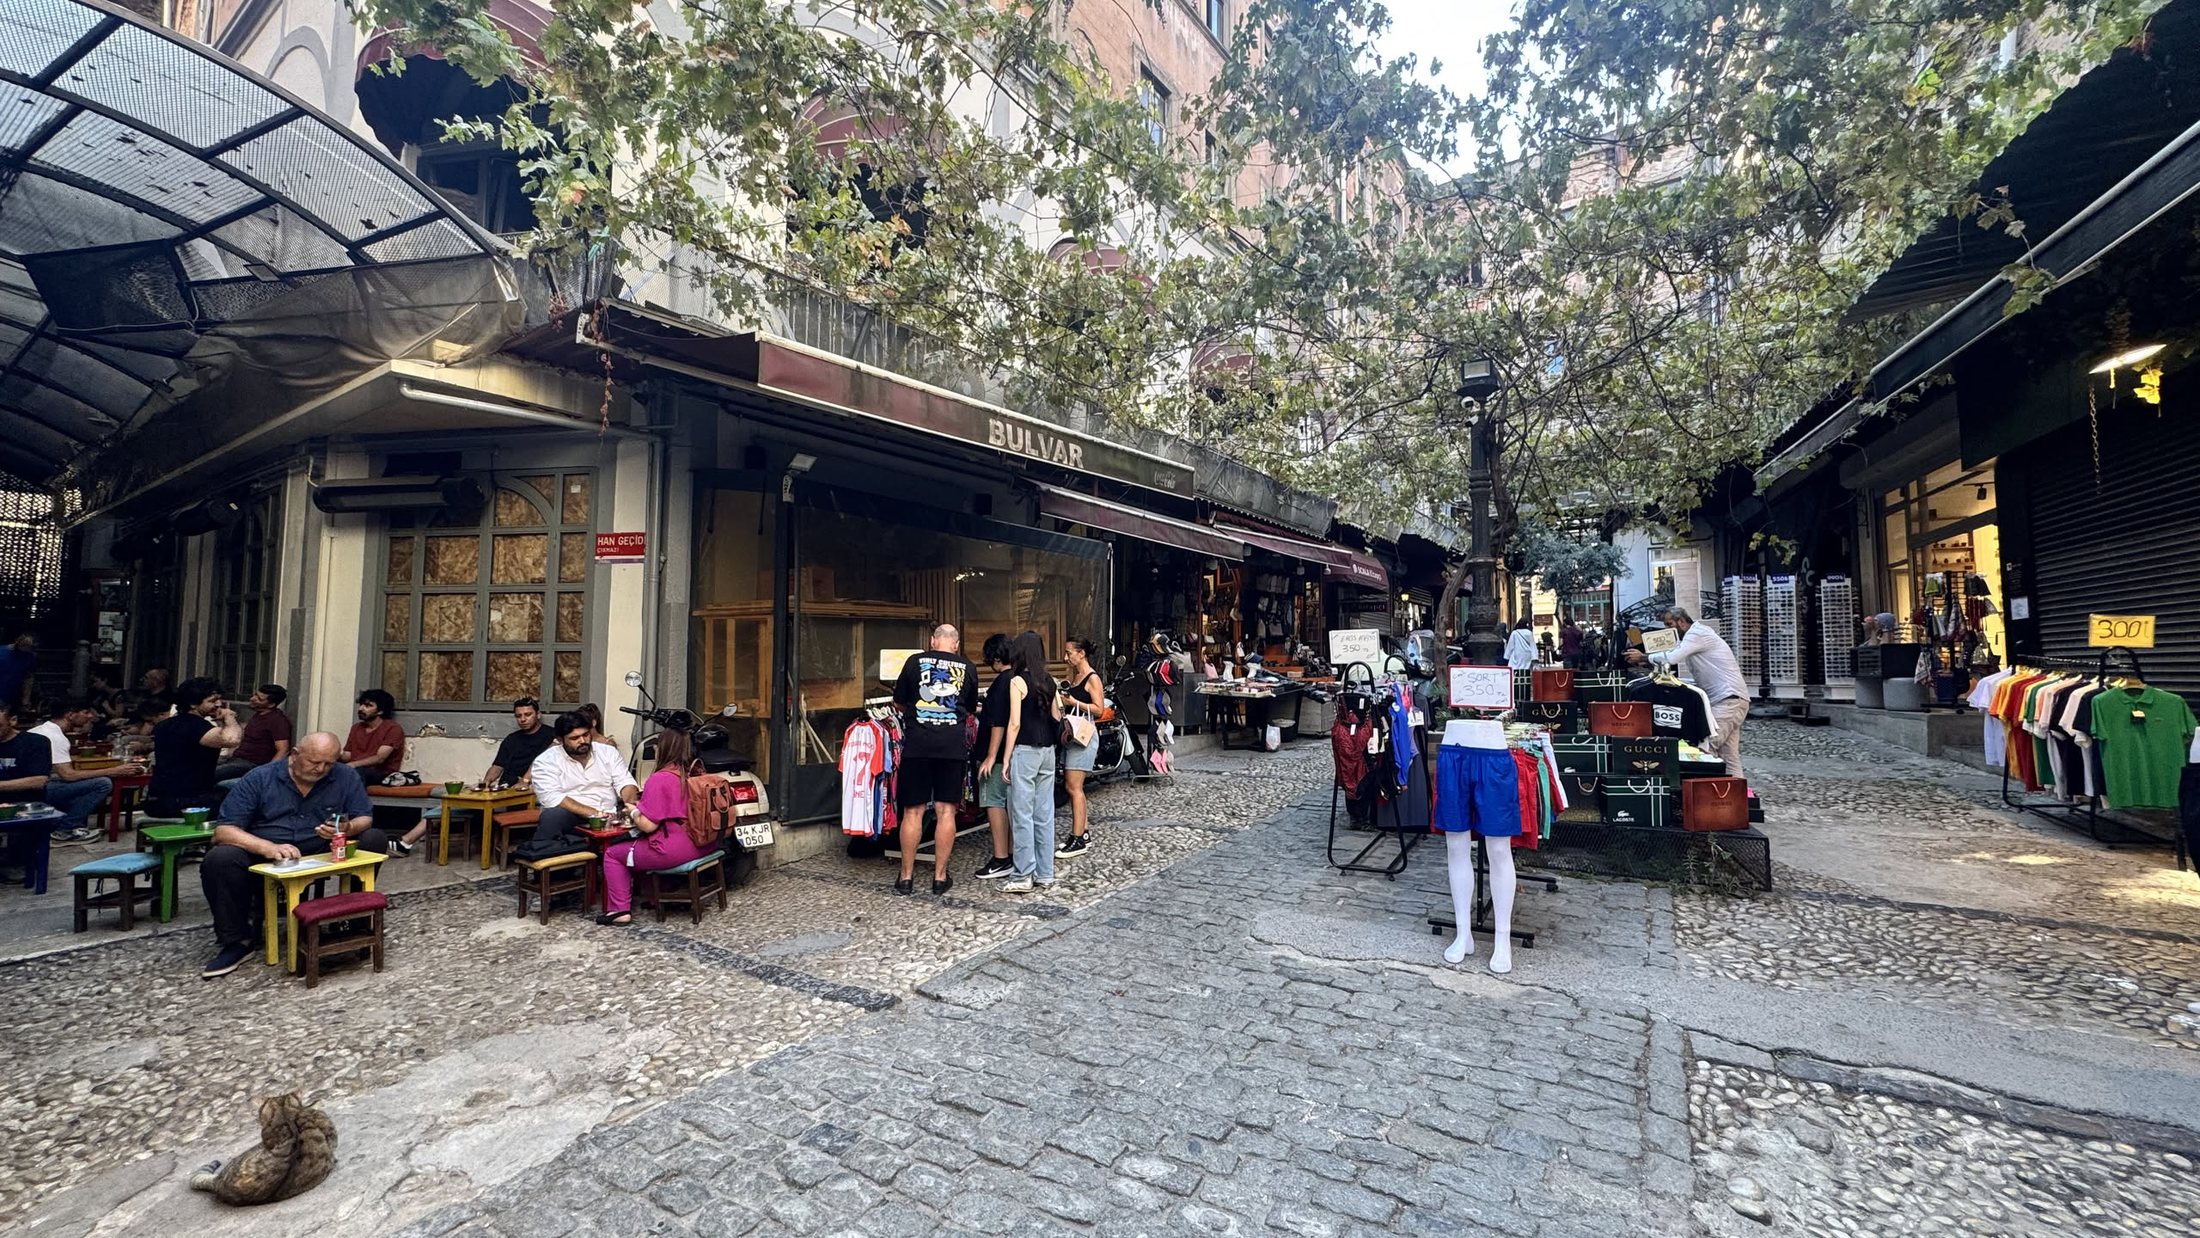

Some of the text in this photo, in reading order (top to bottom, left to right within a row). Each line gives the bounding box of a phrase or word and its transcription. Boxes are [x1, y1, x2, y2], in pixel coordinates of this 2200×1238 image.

[988, 417, 1085, 469] BULVAR
[597, 536, 616, 546] HAN
[1342, 643, 1361, 653] 350
[1462, 684, 1495, 697] 350
[1531, 708, 1569, 717] GUCCI
[1654, 711, 1681, 722] BOSS
[1623, 745, 1668, 754] GUCCI
[736, 827, 750, 837] 34
[745, 834, 764, 846] 050
